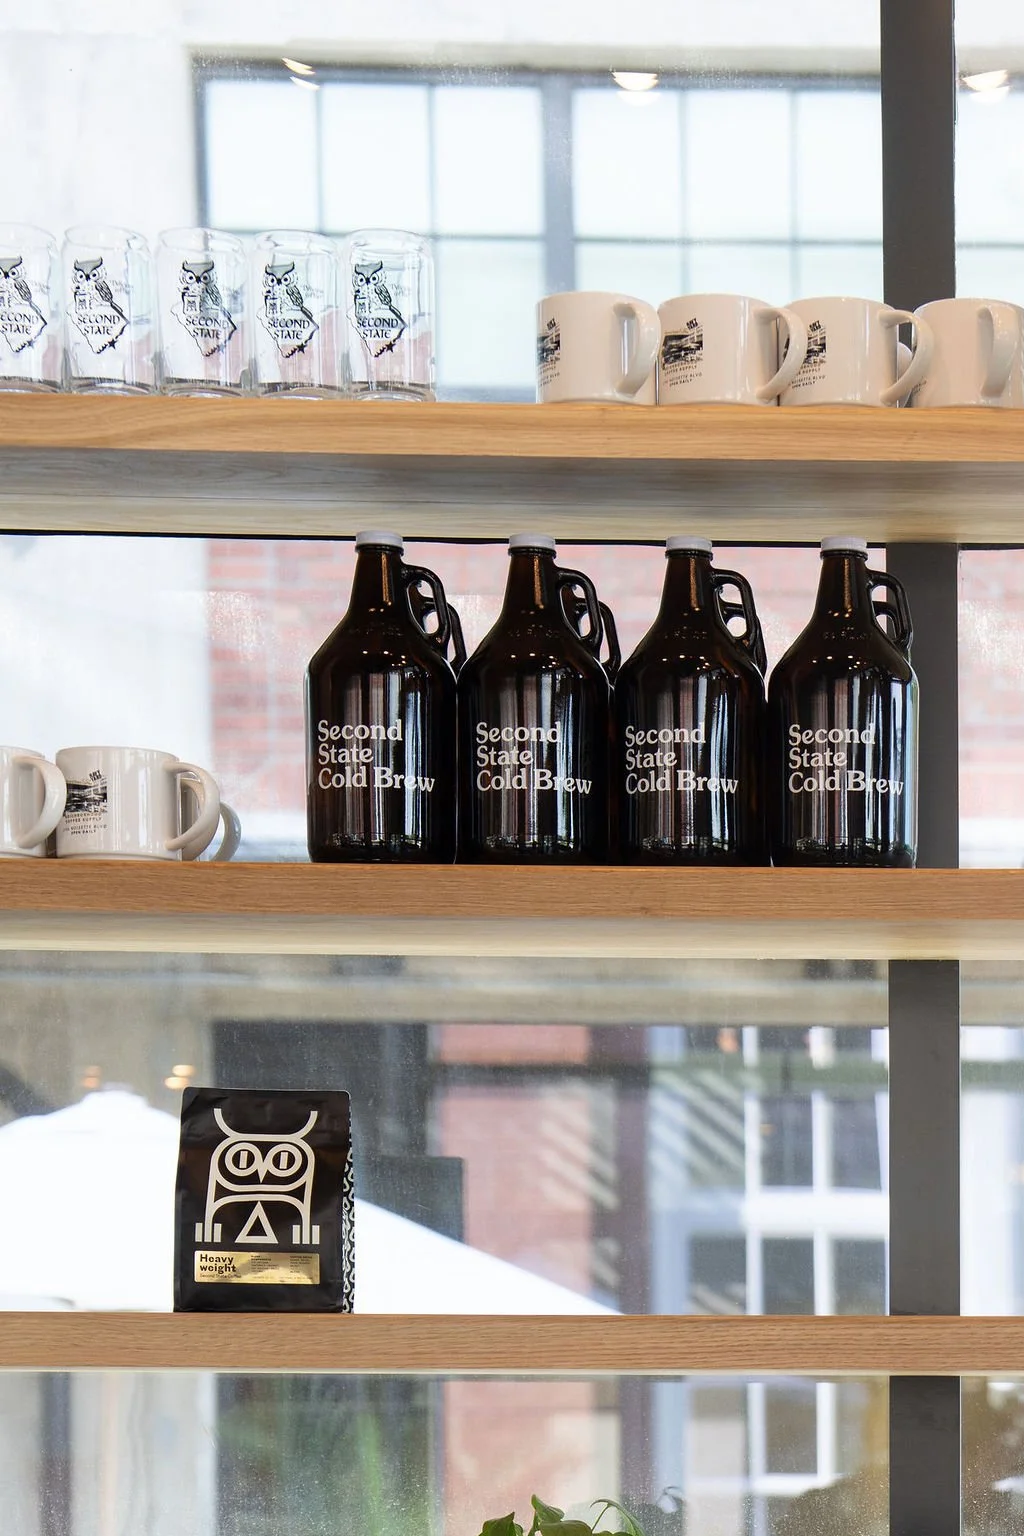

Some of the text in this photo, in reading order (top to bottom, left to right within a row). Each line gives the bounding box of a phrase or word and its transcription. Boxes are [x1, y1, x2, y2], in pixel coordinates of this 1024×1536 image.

[0, 312, 38, 325] ECOND
[78, 311, 120, 325] SECOND
[186, 316, 230, 329] SECOND
[268, 318, 310, 329] SECOND
[357, 318, 399, 329] SECOND
[1, 323, 32, 335] STATE
[84, 324, 113, 335] STATE
[192, 328, 221, 340] STATE
[273, 329, 302, 339] STATE
[362, 329, 391, 339] STATE
[318, 719, 403, 741] Second
[476, 721, 561, 743] Second
[625, 722, 706, 747] Second
[788, 723, 876, 745] Second
[318, 743, 374, 765] State
[476, 745, 533, 767] State
[625, 748, 677, 771] State
[788, 747, 848, 769] State
[318, 766, 435, 793] Cold Brew
[476, 769, 592, 794] Cold Brew
[625, 770, 738, 795] Cold Brew
[788, 770, 904, 796] Cold Brew
[200, 1254, 234, 1264] Heavy
[200, 1264, 236, 1274] weight
